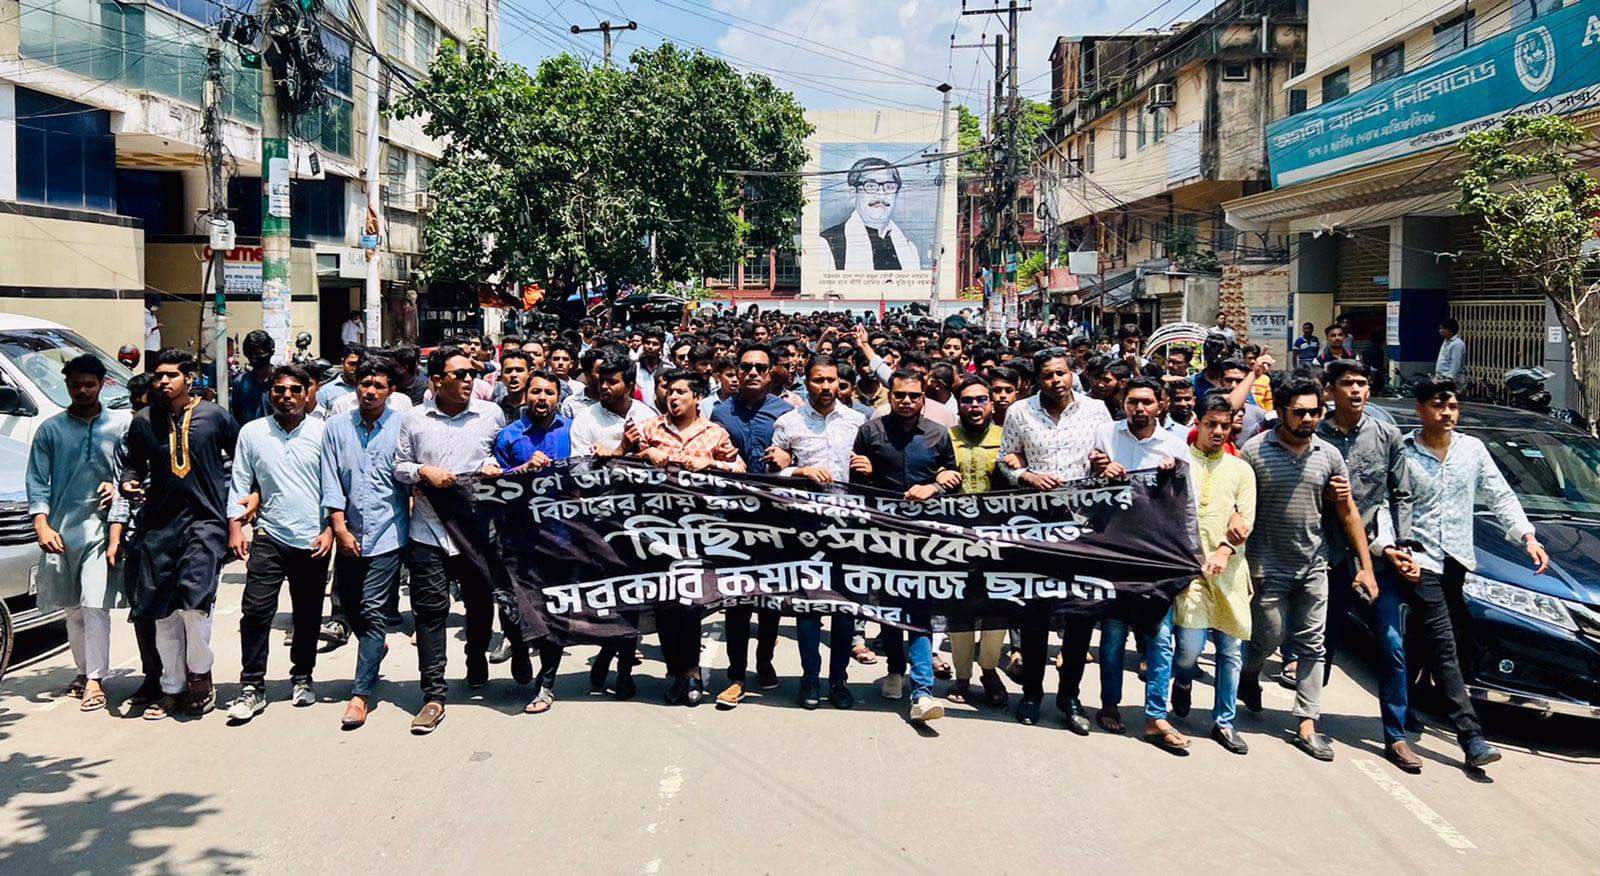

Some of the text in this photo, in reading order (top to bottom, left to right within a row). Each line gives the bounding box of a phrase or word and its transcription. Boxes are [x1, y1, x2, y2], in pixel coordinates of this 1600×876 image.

[1393, 59, 1496, 111] লিমিটেড
[472, 478, 524, 504] ২১
[528, 492, 636, 523] বিচারের
[641, 492, 696, 514] রায়
[603, 514, 797, 560] মিছিল
[816, 524, 1004, 566] সমাবেশ
[542, 558, 705, 617] সরকারি
[714, 551, 833, 596] কমার্স
[841, 563, 969, 600] কলেজ
